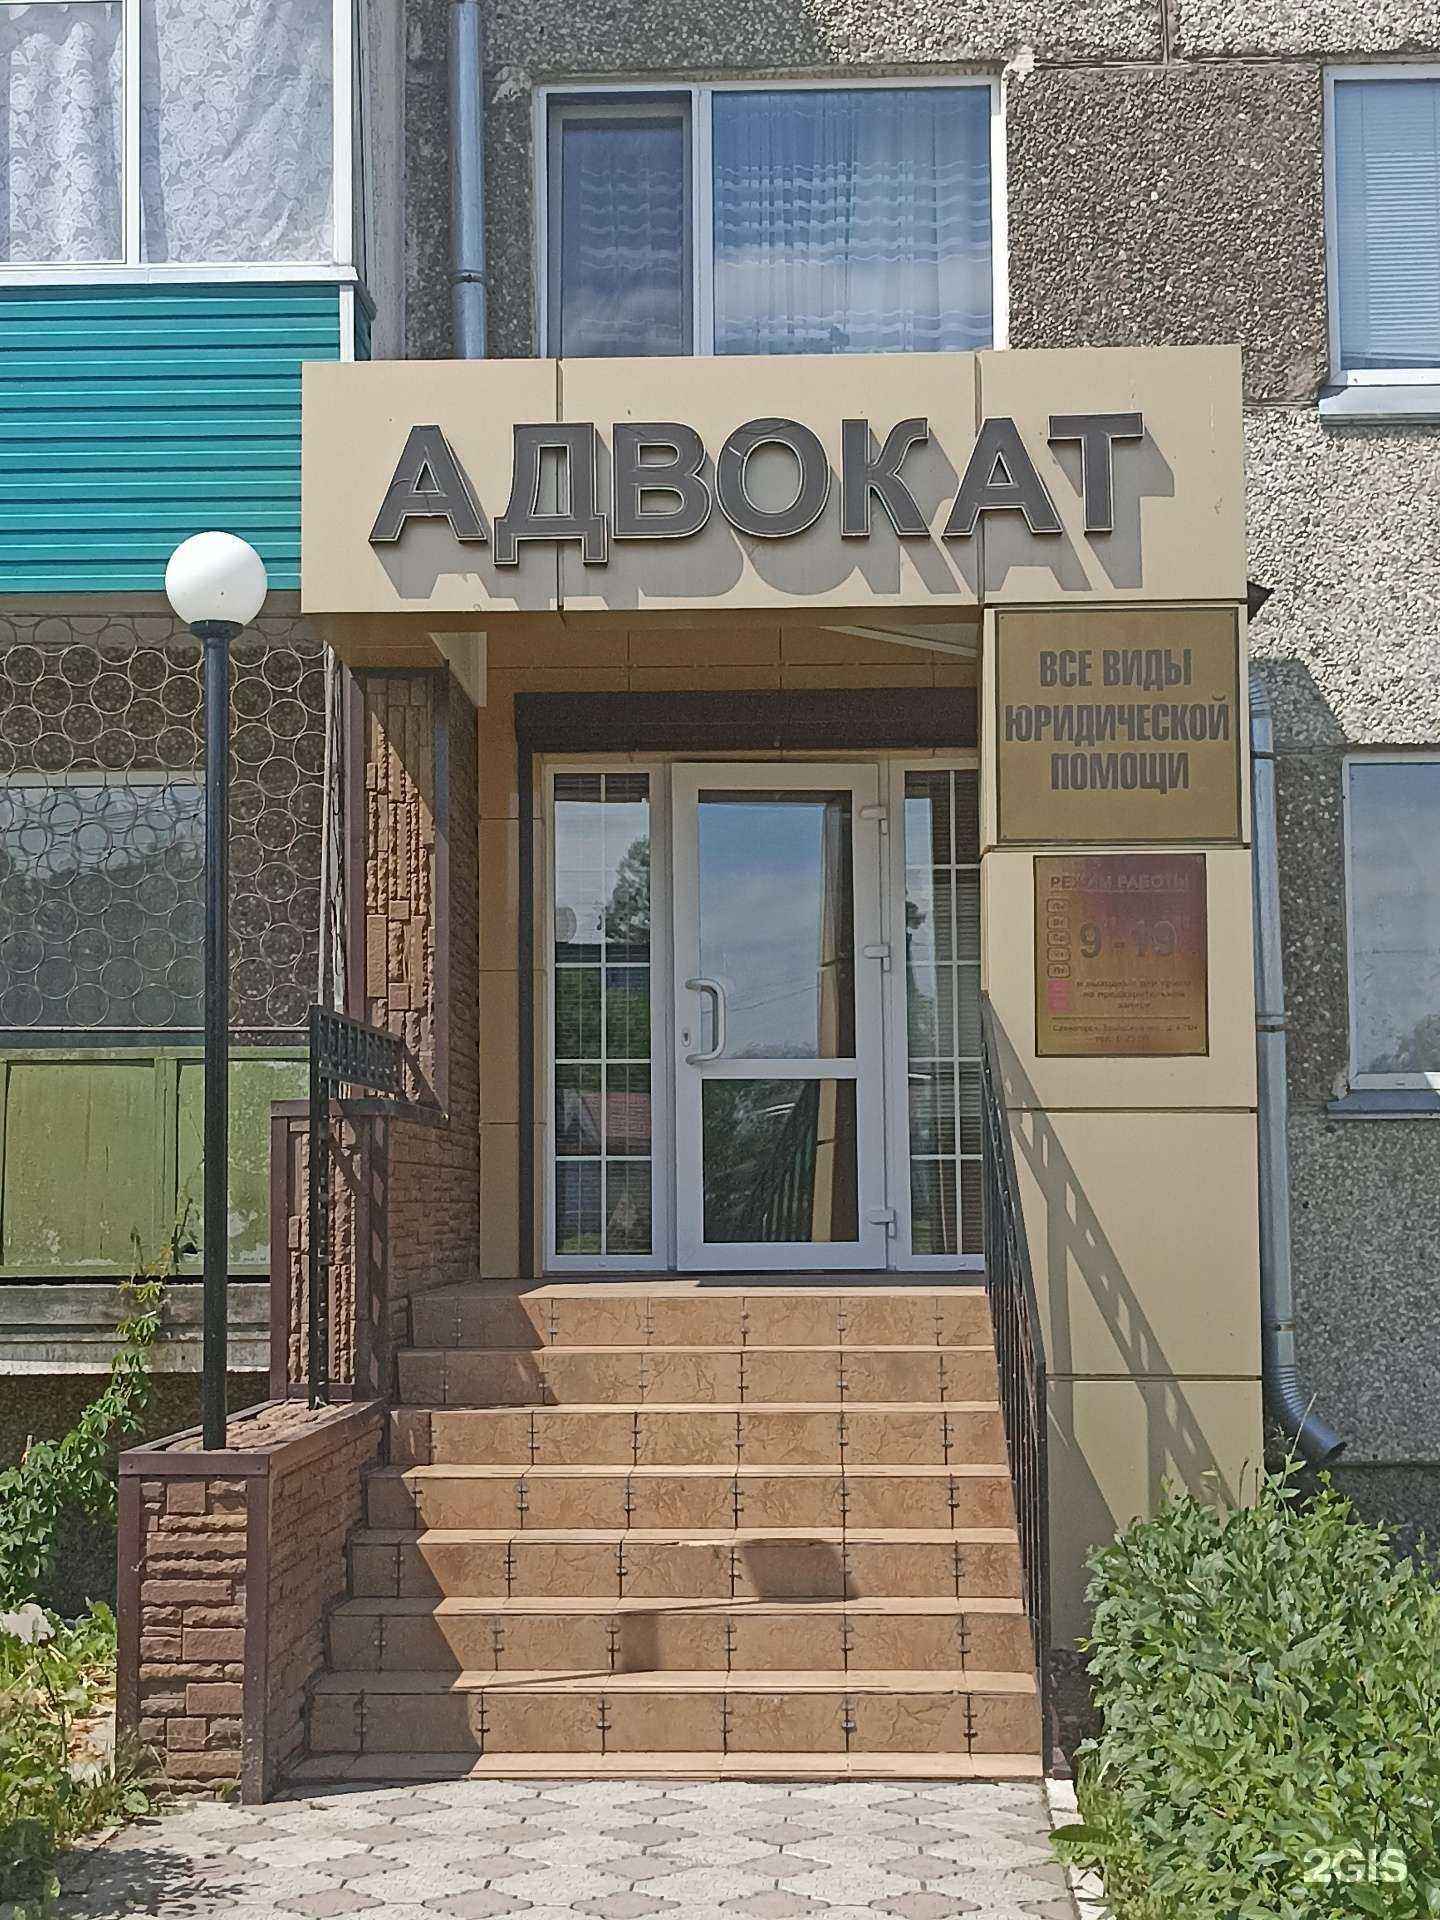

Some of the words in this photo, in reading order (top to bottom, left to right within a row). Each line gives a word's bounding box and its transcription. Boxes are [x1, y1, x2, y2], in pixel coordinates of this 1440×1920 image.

[369, 411, 1145, 567] АДВОКАТ
[1039, 650, 1093, 688] ВСЕ
[1102, 649, 1192, 692] ВИДЫ
[1005, 694, 1230, 747] ЮРИДИЧЕСКОЙ
[1051, 752, 1190, 795] ПОМОЩИ
